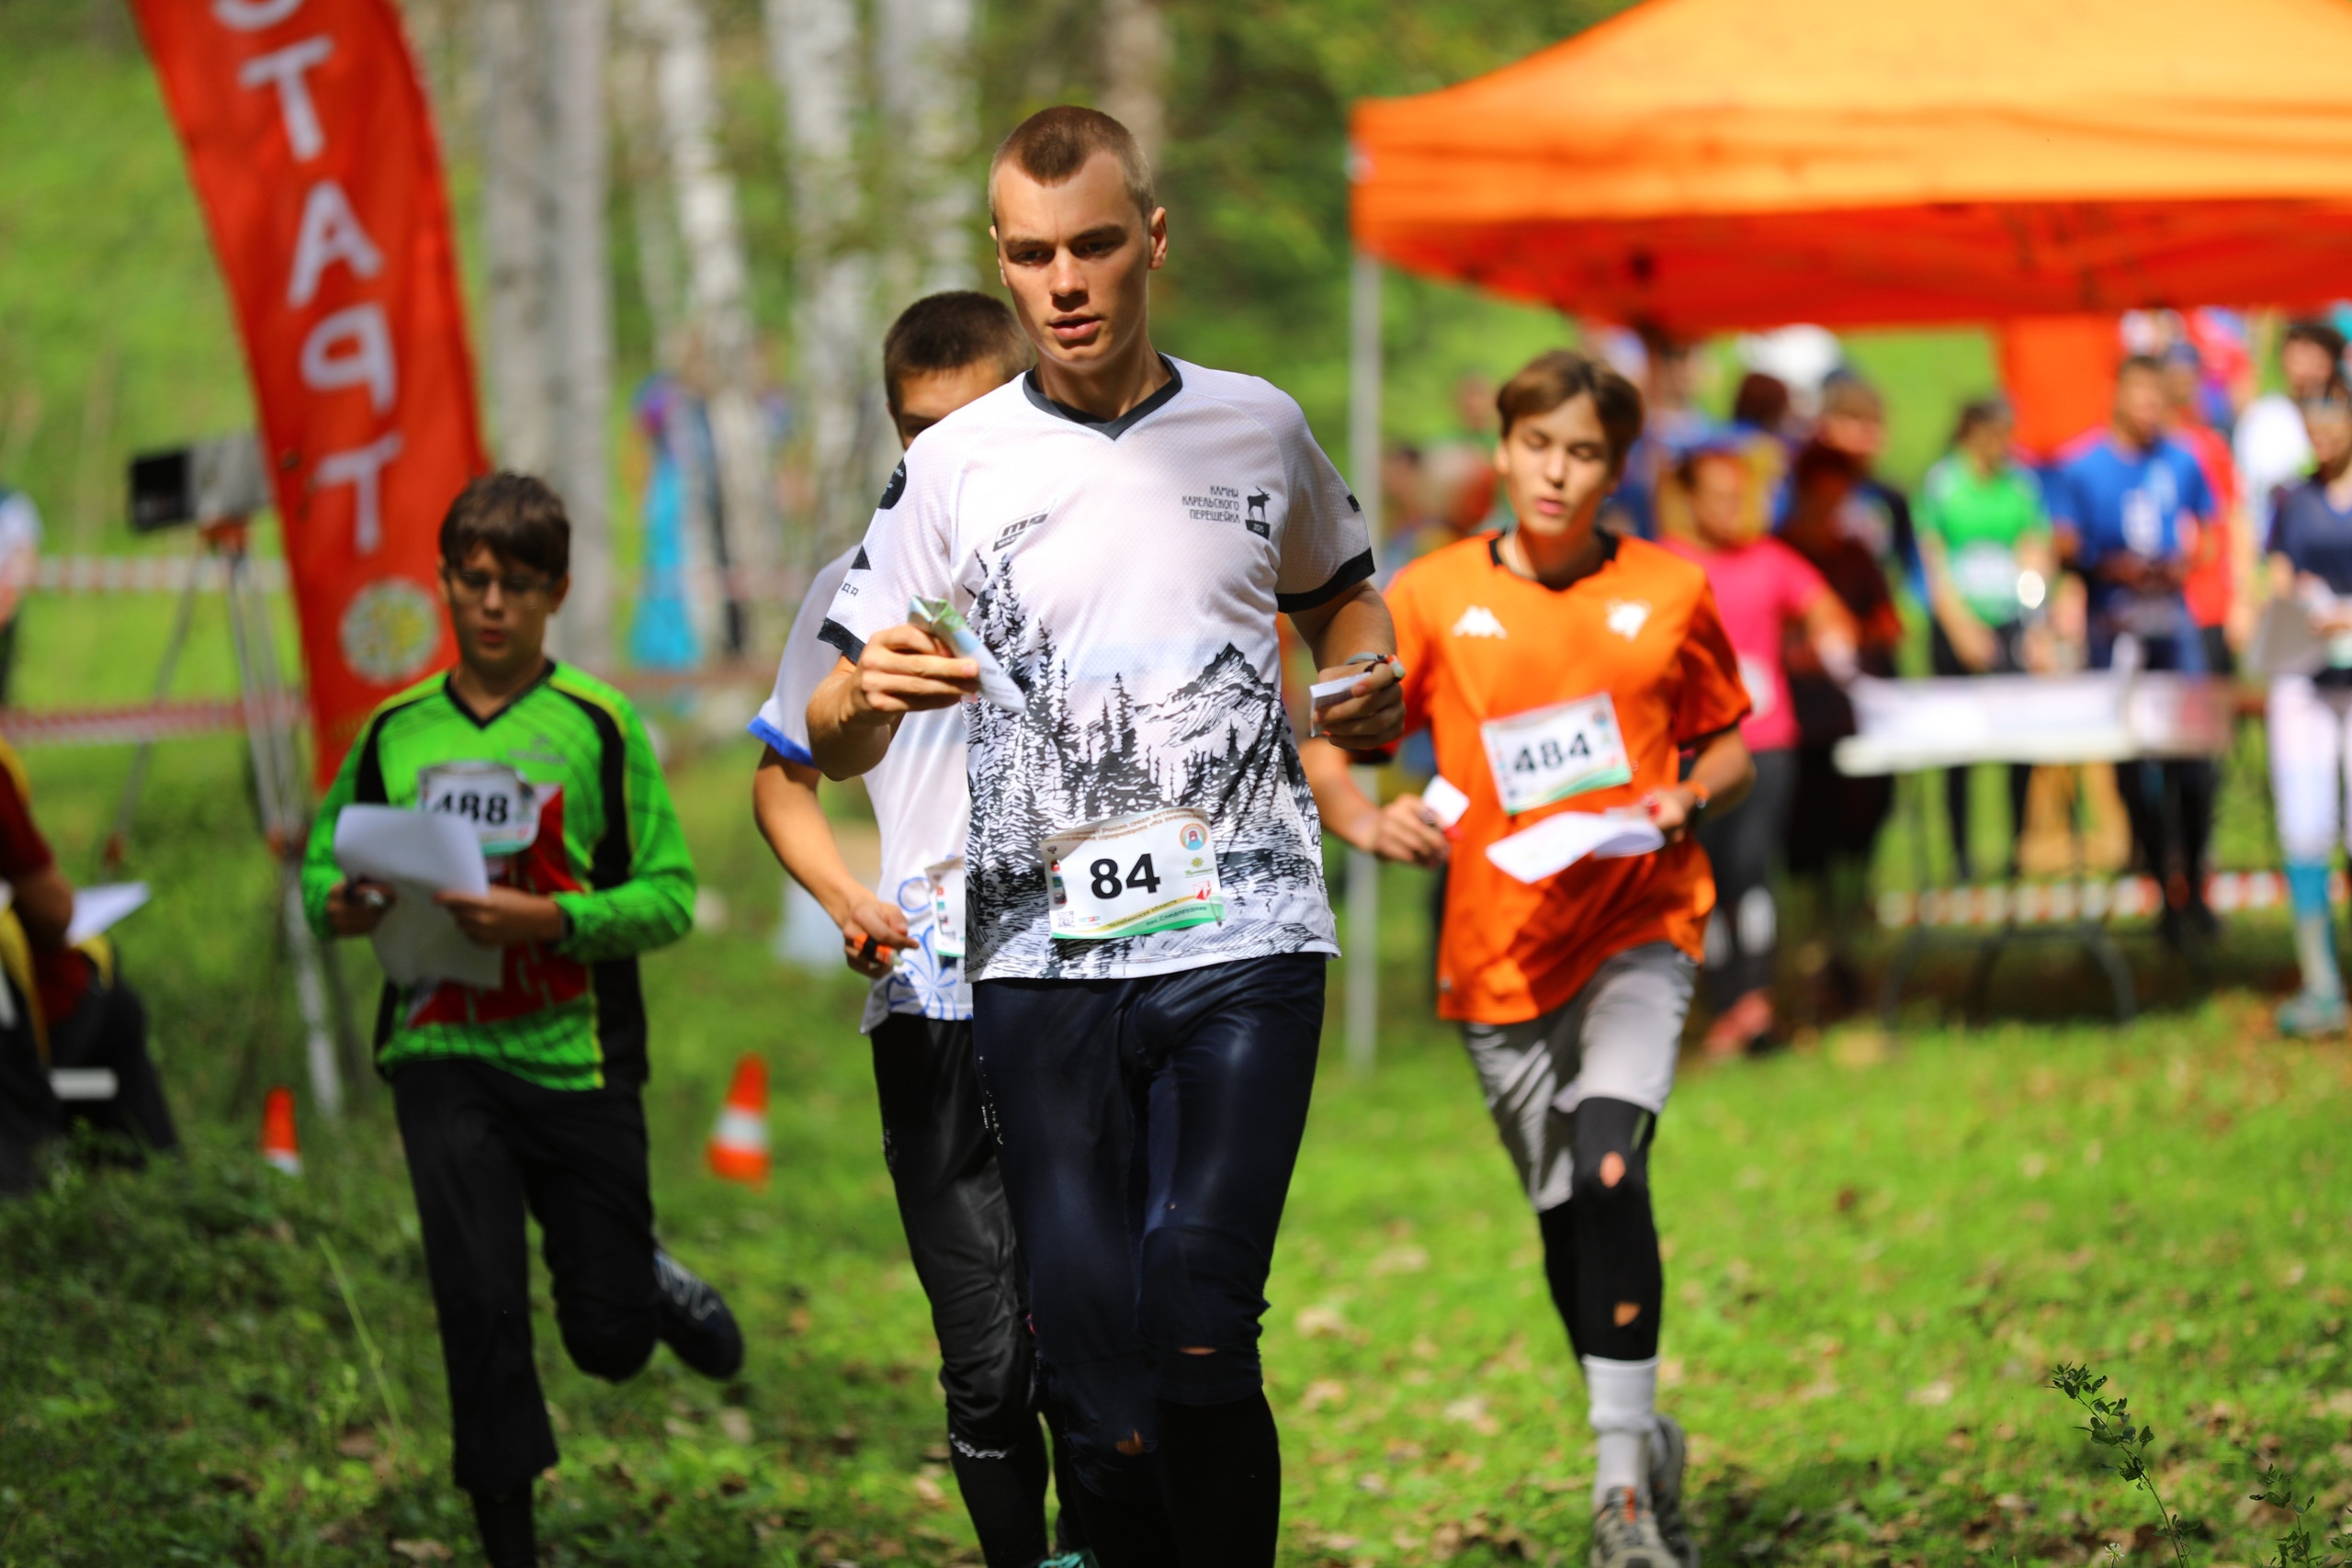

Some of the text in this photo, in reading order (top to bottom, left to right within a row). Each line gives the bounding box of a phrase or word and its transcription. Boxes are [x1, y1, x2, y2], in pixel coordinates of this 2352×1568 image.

[1182, 496, 1239, 511] КАРЕЛЬСКОГО
[1210, 485, 1239, 497] КАМНИ
[1190, 509, 1240, 524] ПЕРЕШЕЙКА
[1515, 730, 1591, 773] 484
[433, 791, 507, 826] 488
[1090, 853, 1161, 899] 84
